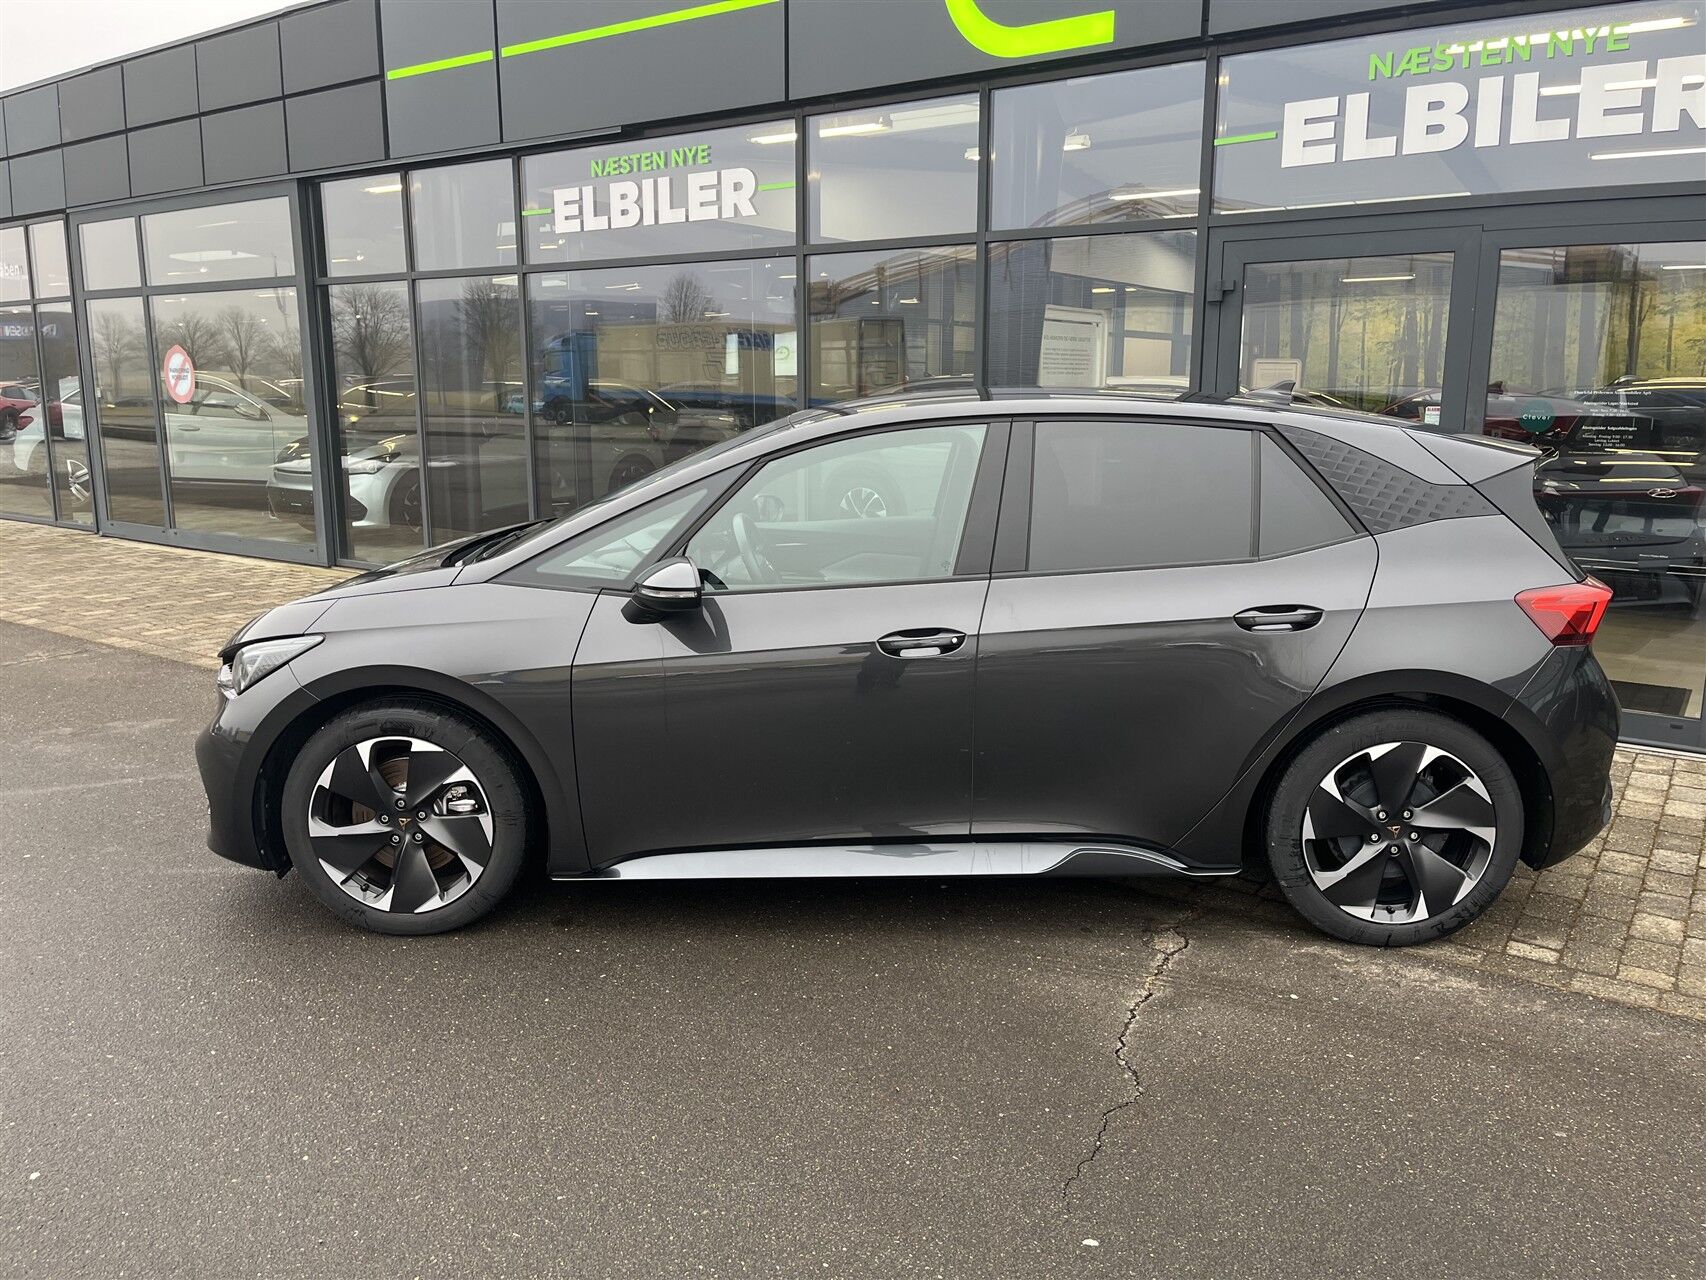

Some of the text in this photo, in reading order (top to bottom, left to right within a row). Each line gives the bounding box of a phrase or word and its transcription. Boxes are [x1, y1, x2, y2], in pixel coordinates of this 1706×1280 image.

[1368, 21, 1632, 81] NÆSTEN NYE
[1280, 55, 1706, 168] ELBILER
[590, 144, 712, 178] NÆSTEN NYE
[553, 167, 758, 234] ELBILER
[1522, 413, 1551, 421] Clever
